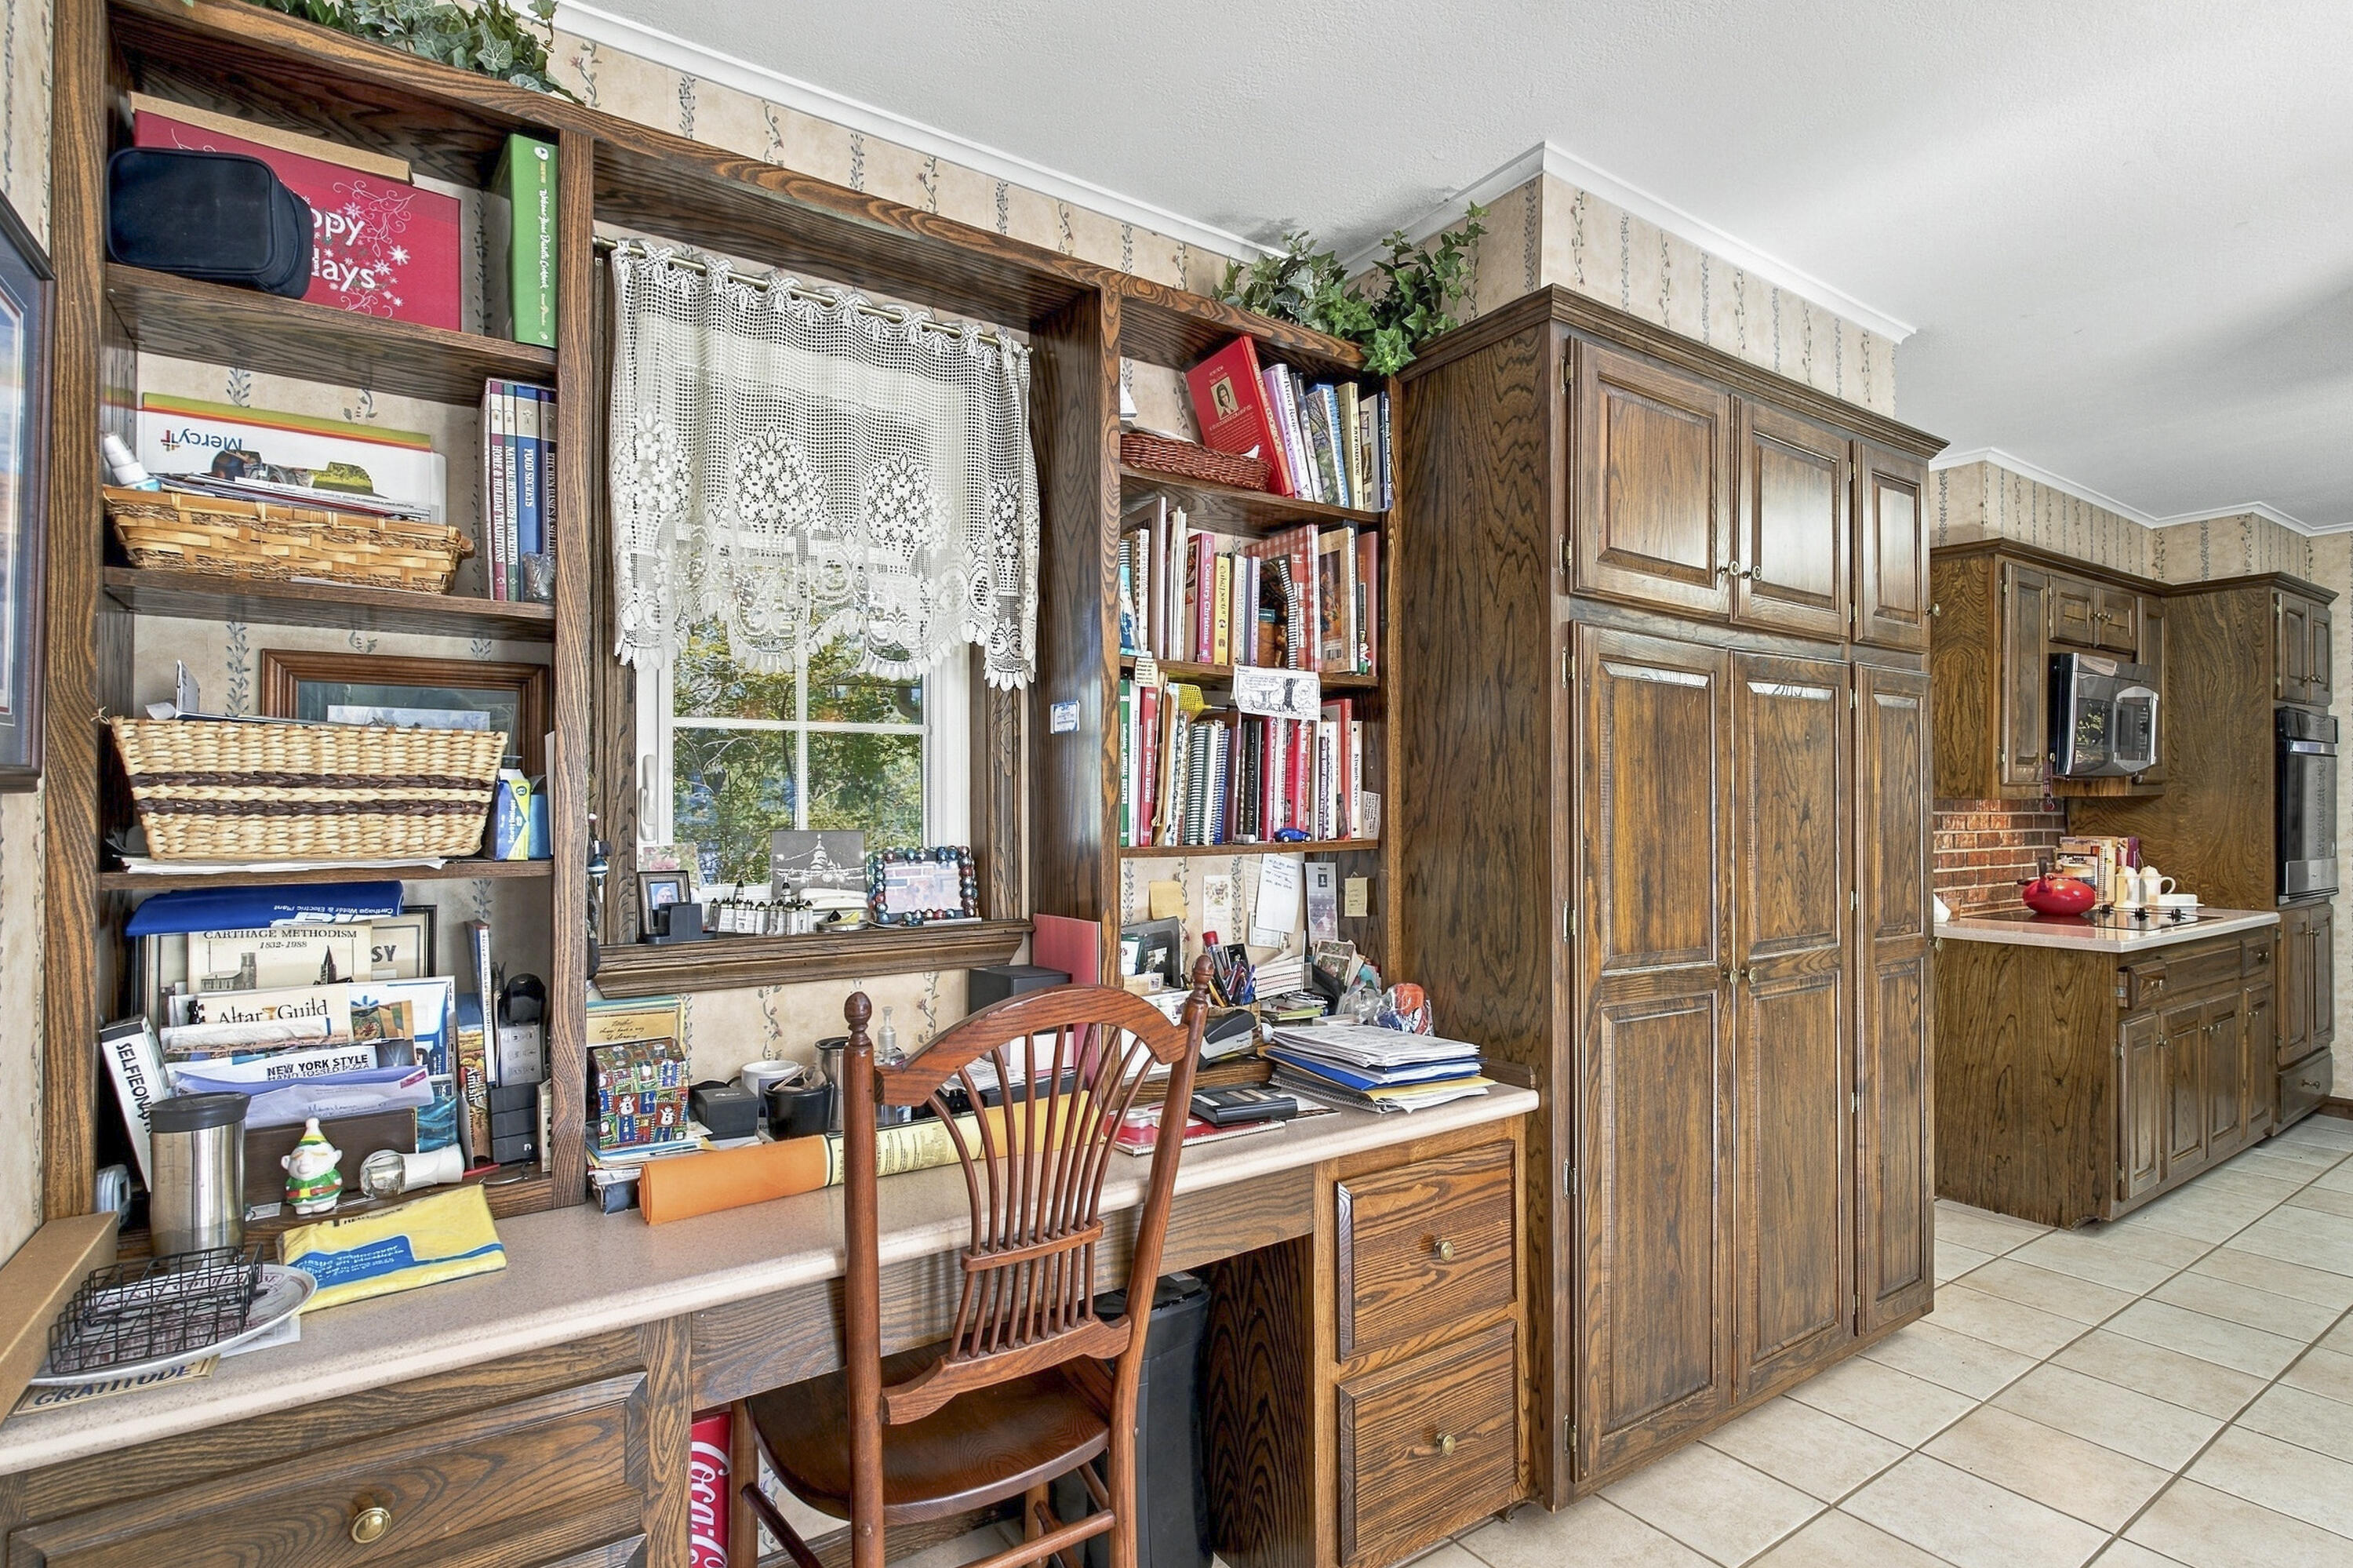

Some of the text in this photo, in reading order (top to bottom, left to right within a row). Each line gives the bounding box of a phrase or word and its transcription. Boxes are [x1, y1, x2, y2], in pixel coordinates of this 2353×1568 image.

[1264, 407, 1284, 453] COOKBOOK
[1288, 408, 1298, 434] Recipe
[179, 428, 242, 451] Mercy
[493, 444, 503, 468] HOME
[505, 446, 516, 480] NATURAL
[546, 452, 555, 487] KITCHEN
[524, 448, 535, 508] FOOD SECRETS
[493, 478, 504, 512] HOLIDAY
[547, 489, 556, 515] BASICS
[494, 514, 505, 562] TRADITIONS
[507, 526, 518, 566] NUTRITION
[204, 930, 358, 939] CARTHAGE METHODISM
[220, 998, 328, 1023] Altar Guild
[267, 1054, 369, 1077] NEW YORK STYLE
[302, 1067, 339, 1078] TOSSED
[467, 1067, 478, 1101] Amish
